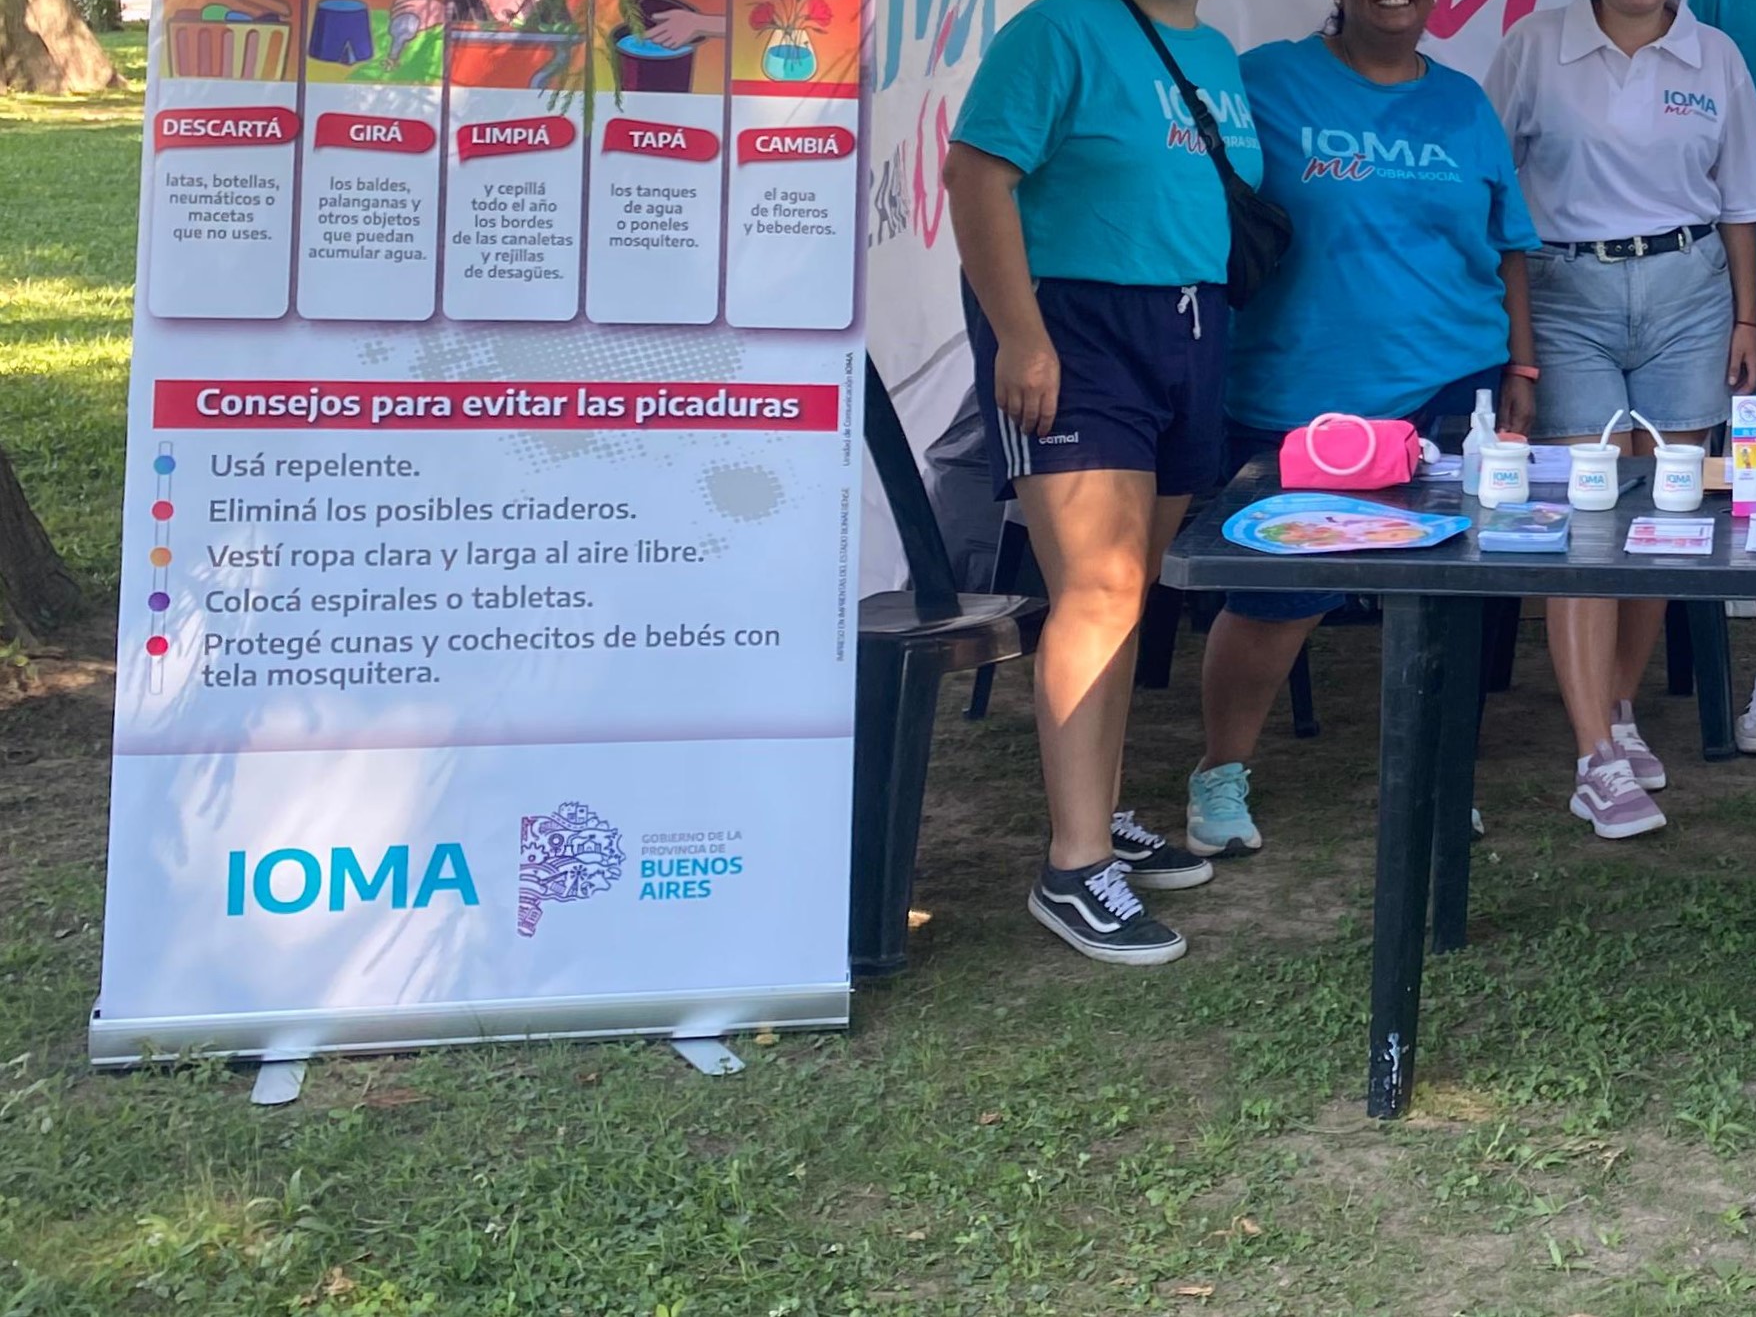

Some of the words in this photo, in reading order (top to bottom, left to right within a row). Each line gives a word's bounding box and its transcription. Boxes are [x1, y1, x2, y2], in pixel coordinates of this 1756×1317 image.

[1664, 90, 1717, 116] IOMA
[163, 117, 282, 138] DESCARTÁ
[349, 121, 403, 143] GIRÁ
[471, 125, 549, 145] LIMPIÁ
[629, 129, 687, 149] TAPÁ
[755, 134, 839, 154] CAMBIÁ
[1301, 126, 1458, 168] IOMA
[1301, 152, 1375, 183] mi
[1376, 168, 1416, 179] OBRA
[166, 173, 208, 189] latas,
[213, 174, 280, 190] botellas,
[330, 176, 352, 191] los
[357, 177, 411, 193] baldes,
[484, 185, 493, 197] y
[498, 182, 546, 197] cepillá
[170, 191, 260, 206] neumáticos
[265, 195, 275, 206] o
[611, 184, 632, 197] los
[636, 186, 696, 200] tanques
[764, 188, 777, 200] el
[780, 190, 815, 203] agua
[319, 196, 407, 212] palanganas
[411, 198, 421, 212] y
[471, 198, 507, 211] todo
[512, 199, 525, 211] el
[529, 199, 557, 212] año
[624, 201, 643, 214] de
[646, 203, 683, 217] agua
[751, 204, 769, 217] de
[772, 205, 828, 219] floreros
[188, 210, 254, 222] macetas
[318, 212, 358, 226] otros
[363, 213, 420, 229] objetos
[475, 215, 496, 228] los
[501, 215, 553, 229] bordes
[617, 220, 626, 230] o
[630, 218, 688, 233] poneles
[744, 223, 754, 235] y
[757, 221, 836, 236] bebederos.
[173, 228, 202, 240] que
[207, 228, 227, 239] no
[232, 228, 272, 240] uses.
[323, 230, 352, 244] que
[356, 230, 413, 244] puedan
[452, 231, 471, 244] de
[476, 232, 497, 245] las
[501, 232, 573, 246] canaletas
[609, 234, 699, 248] mosquitero.
[308, 246, 380, 260] acumular
[385, 249, 426, 262] agua.
[481, 252, 490, 264] y
[495, 249, 544, 264] rejillas
[464, 265, 483, 278] de
[488, 265, 564, 281] desagües.
[196, 388, 360, 422] Consejos
[372, 394, 451, 423] para
[462, 389, 568, 418] evitar
[577, 389, 624, 417] las
[636, 390, 799, 423] picaduras
[211, 453, 265, 477] Usá
[276, 454, 420, 482] repelente.
[208, 498, 316, 522] Eliminá
[328, 498, 366, 522] los
[376, 497, 493, 527] posibles
[502, 497, 637, 521] criaderos.
[207, 543, 284, 567] Vestí
[291, 548, 354, 571] ropa
[365, 543, 431, 567] clara
[440, 548, 457, 570] y
[467, 541, 536, 570] larga
[546, 540, 568, 564] al
[578, 541, 628, 563] aire
[637, 540, 704, 563] libre.
[205, 588, 301, 612] Colocá
[311, 587, 437, 617] espirales
[446, 592, 462, 609] o
[472, 586, 593, 609] tabletas.
[204, 630, 321, 659] Protegé
[331, 634, 413, 653] cunas
[422, 636, 438, 658] y
[448, 627, 595, 651] cochecitos
[604, 626, 636, 648] de
[645, 624, 725, 647] bebés
[734, 627, 780, 646] con
[203, 663, 256, 687] tela
[268, 662, 440, 690] mosquitera.
[642, 832, 705, 843] GOBIERNO
[708, 832, 724, 840] DE
[727, 831, 742, 840] LA
[641, 845, 706, 855] PROVINCIA
[709, 844, 726, 853] DE
[641, 856, 742, 878] BUENOS
[227, 843, 479, 916] IOMA
[639, 880, 711, 900] AIRES
